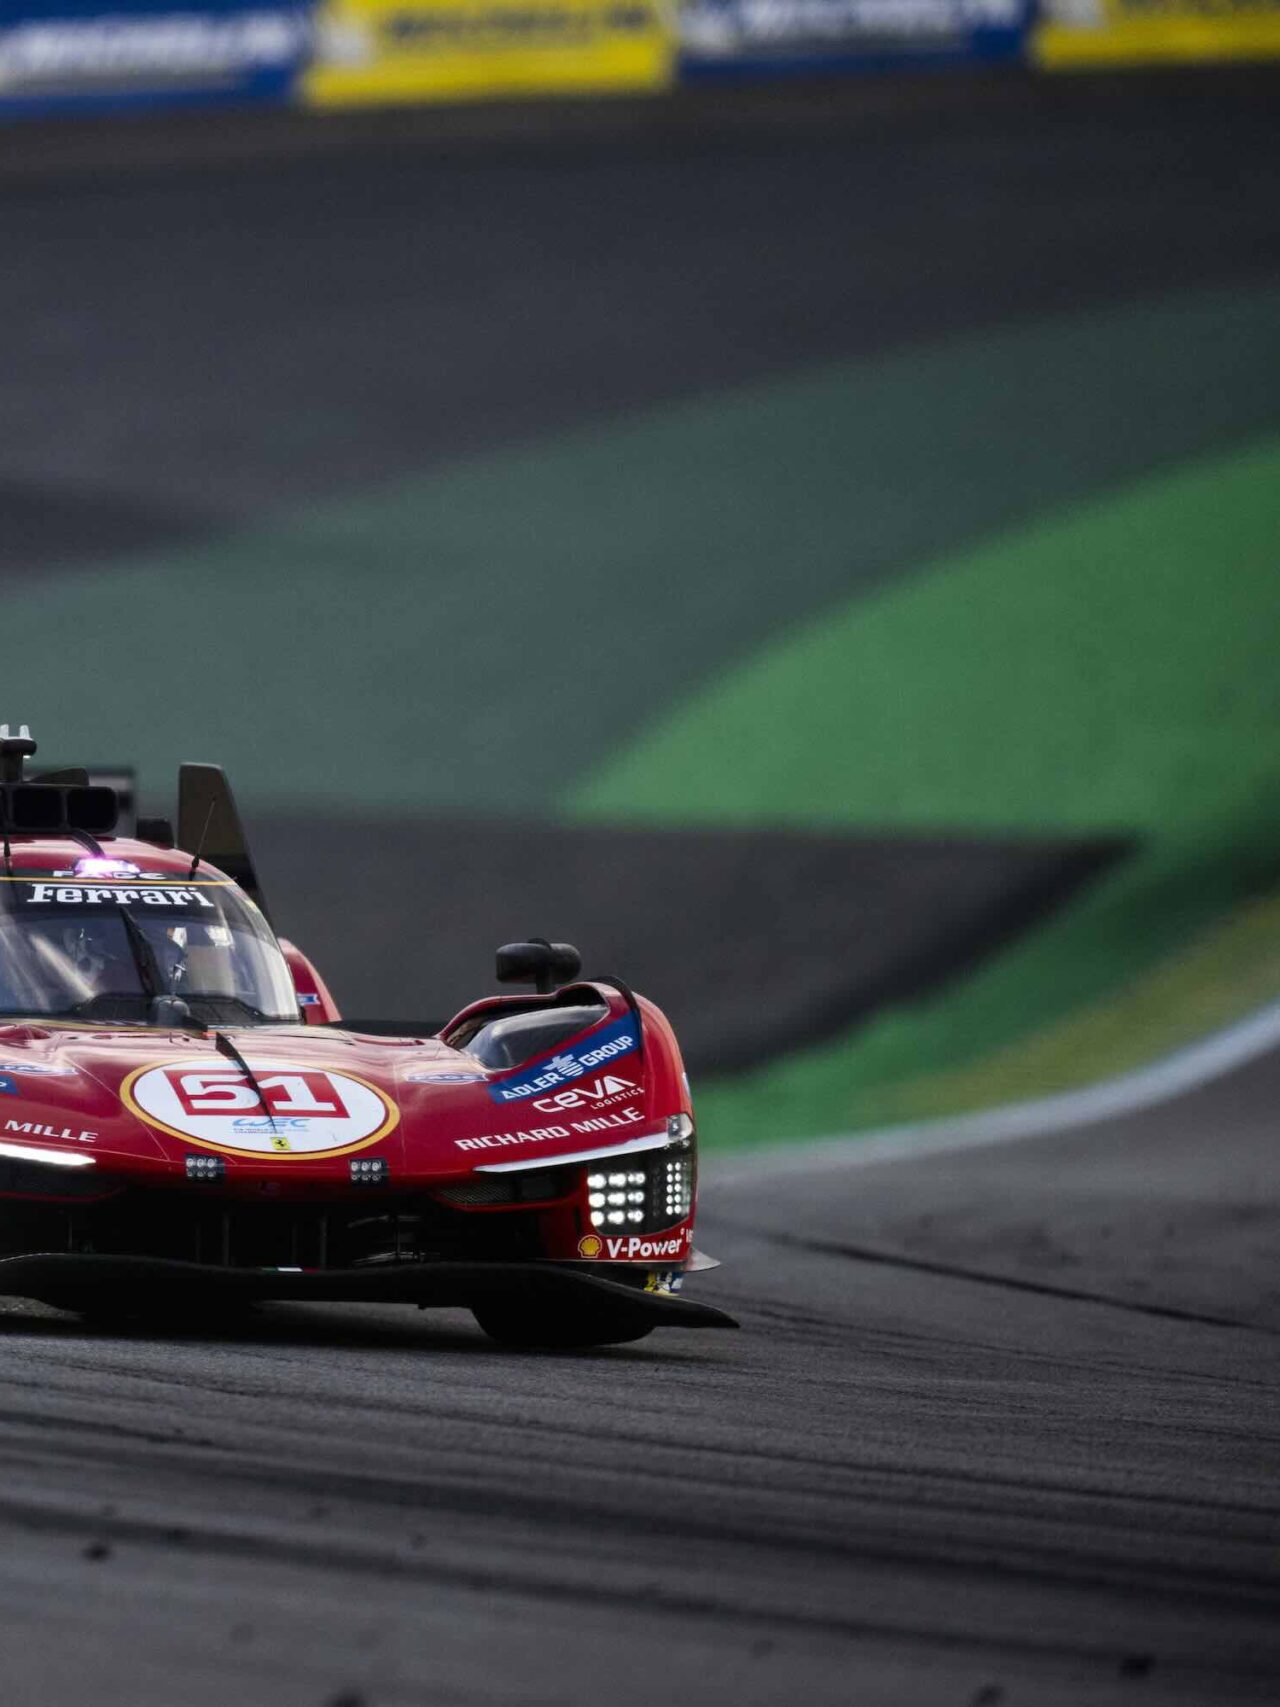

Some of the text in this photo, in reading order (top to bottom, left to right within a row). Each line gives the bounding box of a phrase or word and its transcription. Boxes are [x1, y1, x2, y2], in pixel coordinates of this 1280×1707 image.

[27, 883, 214, 907] Ferrari
[501, 1035, 634, 1100] ADLER GROUP
[180, 1074, 337, 1111] 51
[591, 1087, 645, 1110] LOGISTICS
[5, 1119, 98, 1143] MILLE
[453, 1106, 645, 1151] RICHARD MILLE
[606, 1237, 682, 1259] V-Power
